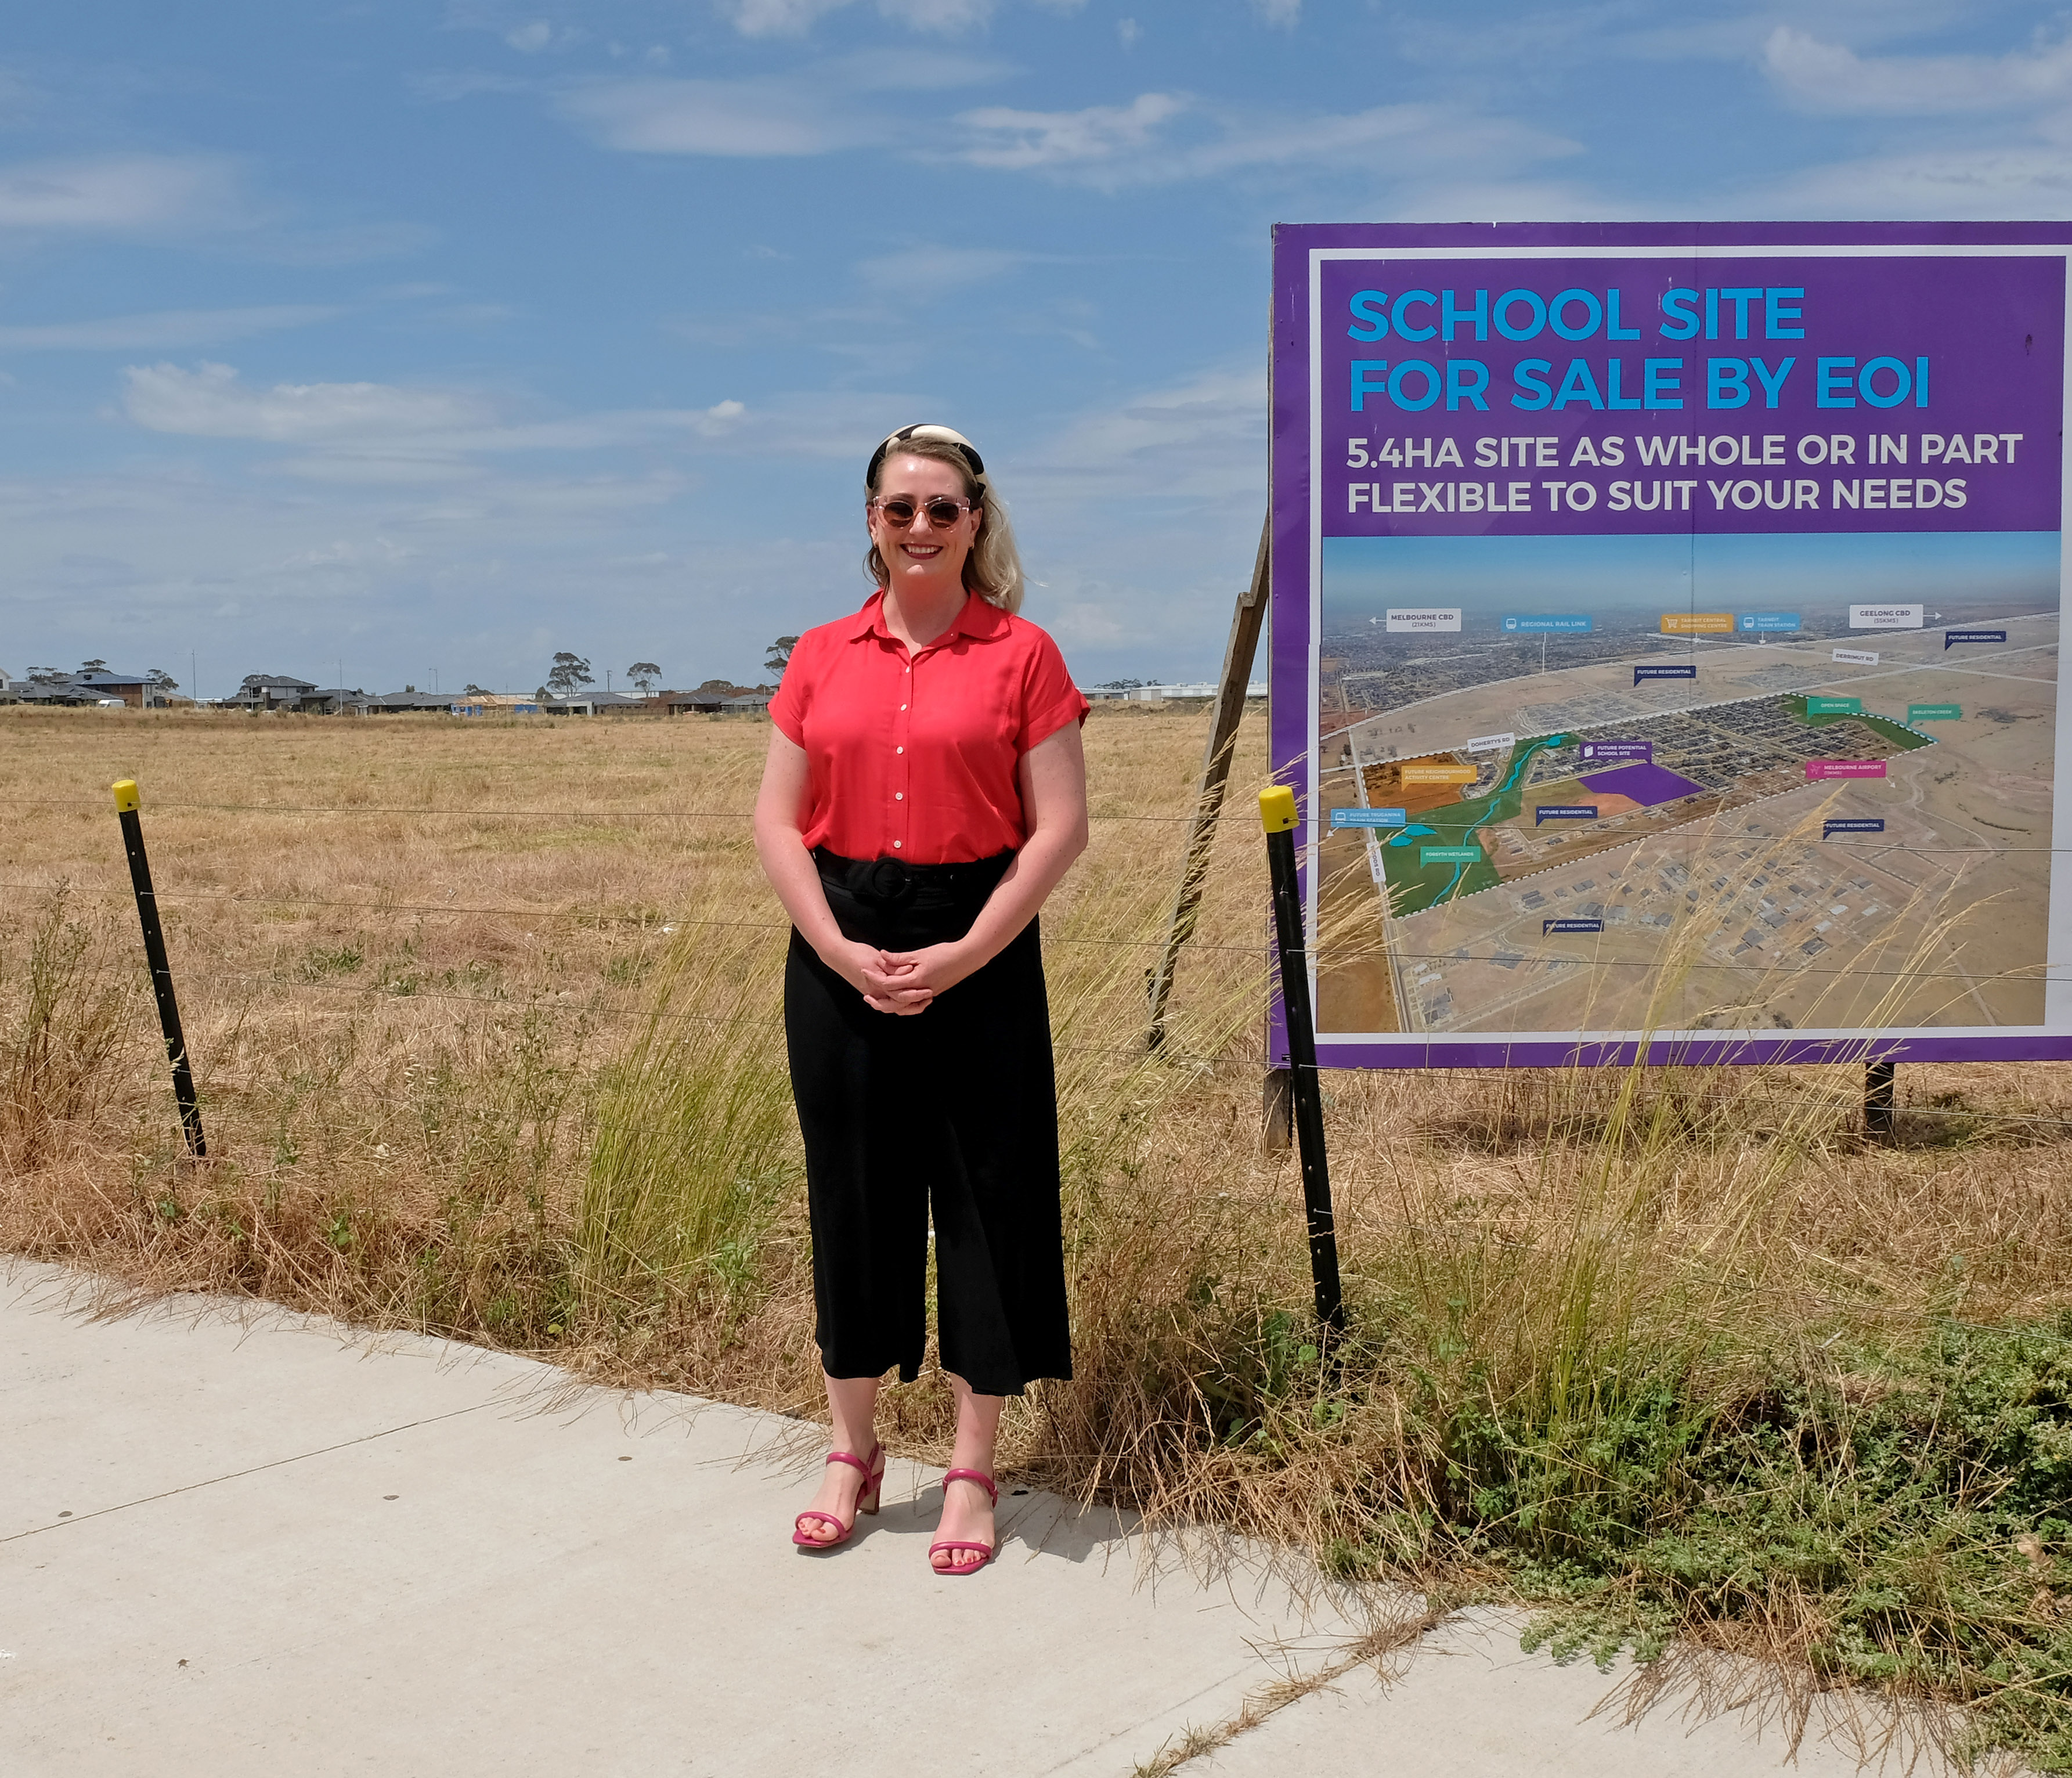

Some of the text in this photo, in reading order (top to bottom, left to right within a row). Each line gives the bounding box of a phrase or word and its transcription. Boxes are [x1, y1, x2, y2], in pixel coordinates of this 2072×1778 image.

[1348, 288, 1804, 341] SCHOOL SITE
[1351, 357, 1928, 411] FOR SALE BY EOI
[1347, 434, 2023, 468] 5.4HA SITE AS WHOLE OR IN PART
[1349, 479, 1966, 513] FLEXIBLE TO SUIT YOUR NEEDS
[1471, 738, 1501, 748] DOHERTYS
